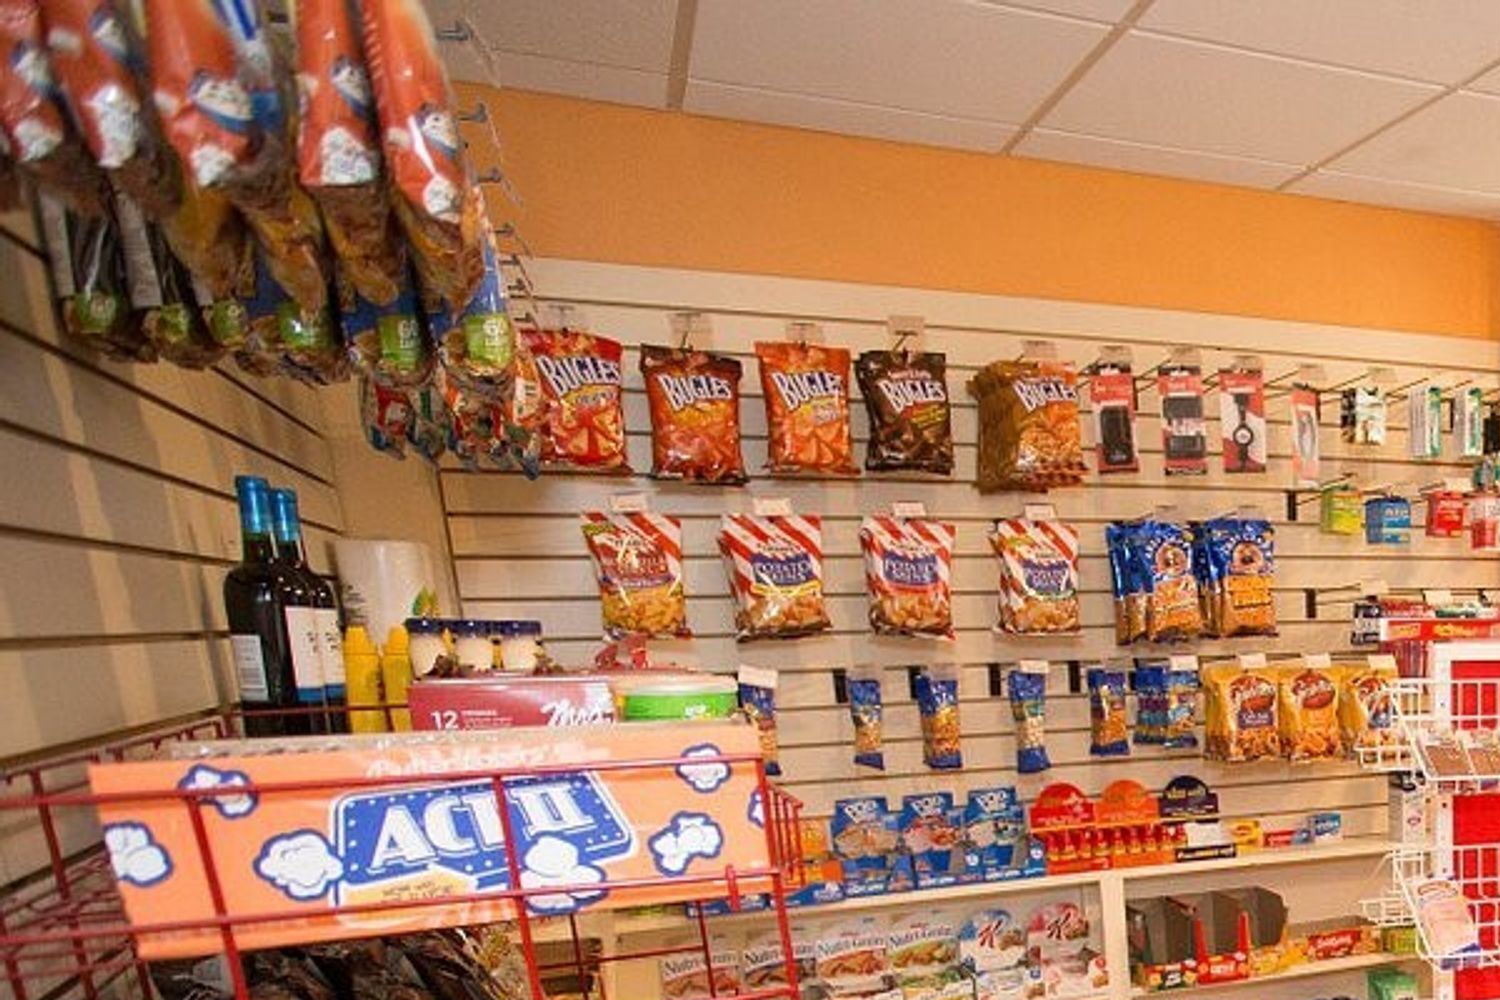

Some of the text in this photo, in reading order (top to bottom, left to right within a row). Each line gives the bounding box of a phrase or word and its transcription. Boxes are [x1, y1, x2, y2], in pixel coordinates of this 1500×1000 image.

[536, 354, 621, 399] BUGLES
[657, 373, 732, 411] BUGLES
[878, 378, 946, 414] BUGLES
[430, 710, 459, 729] 12
[368, 784, 596, 875] ACT II
